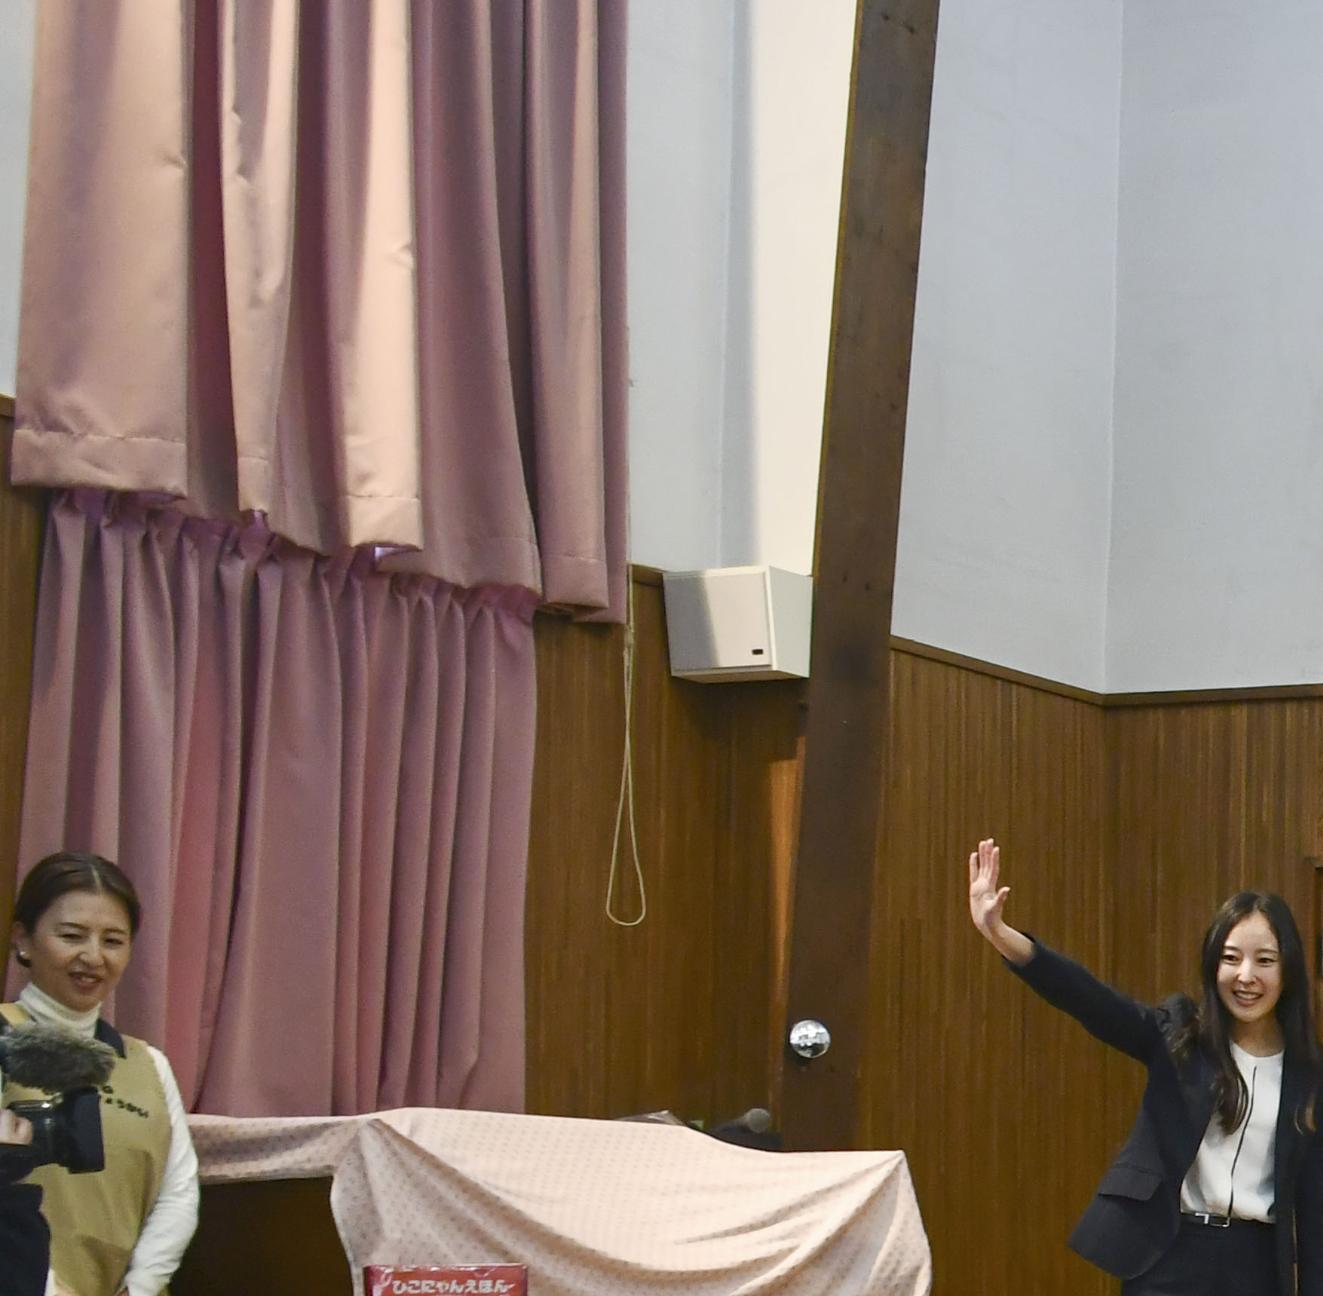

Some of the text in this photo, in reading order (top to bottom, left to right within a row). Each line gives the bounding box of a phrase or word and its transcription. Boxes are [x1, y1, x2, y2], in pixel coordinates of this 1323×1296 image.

[391, 1279, 511, 1294] ひこにゃんえほん
